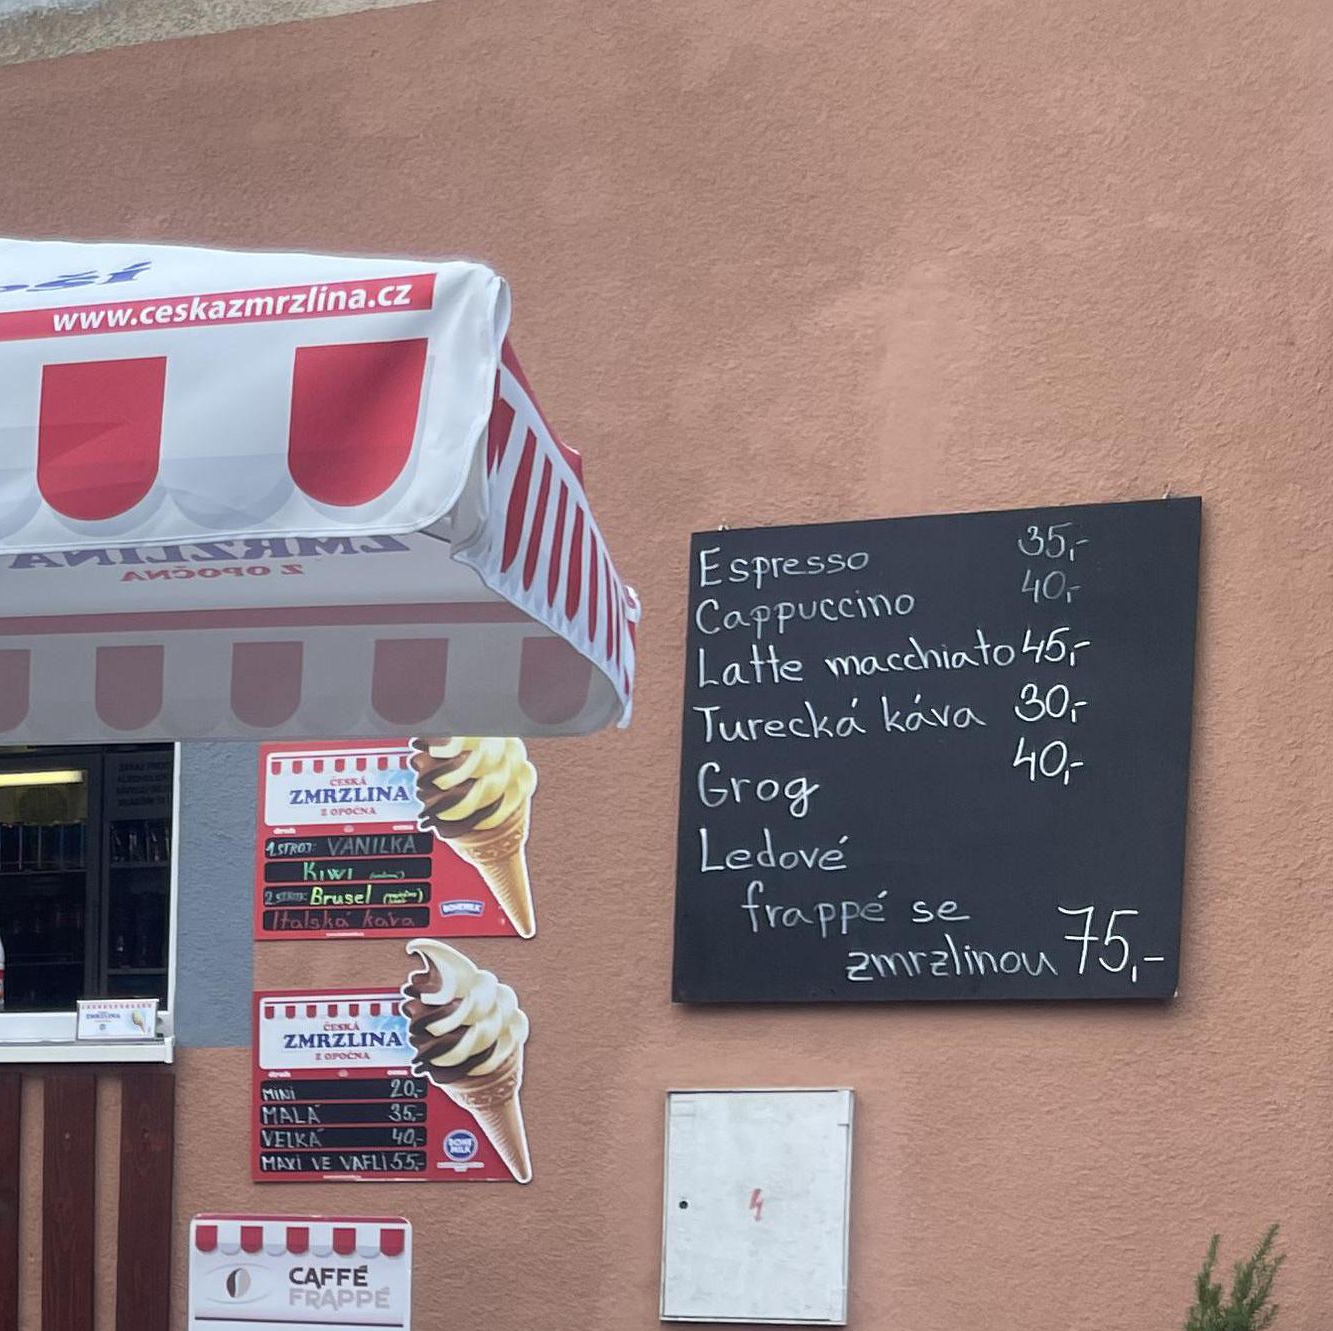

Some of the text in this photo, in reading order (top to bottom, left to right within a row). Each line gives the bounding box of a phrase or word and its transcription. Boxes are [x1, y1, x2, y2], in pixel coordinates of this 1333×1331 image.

[53, 284, 413, 331] www.ceskazmrzlina.cz
[700, 522, 1089, 588] Espresso 35,-
[695, 569, 1082, 637] Cappuccino 40,-
[699, 627, 1091, 688] Latte macchiato 45,-
[693, 684, 1088, 743] Turecká káva 30,-
[289, 786, 410, 805] ZMRZLINA
[698, 737, 1084, 818] Grog 40,-
[327, 836, 417, 856] VANILKA
[700, 827, 849, 872] Ledové
[741, 881, 970, 937] frappé se
[846, 906, 1164, 982] zmrzlinou 75,-
[283, 1031, 403, 1049] ZMRZLINA
[311, 1156, 332, 1171] VE
[288, 1265, 369, 1290] CAFFÉ
[288, 1286, 391, 1311] FRAPPÉ
